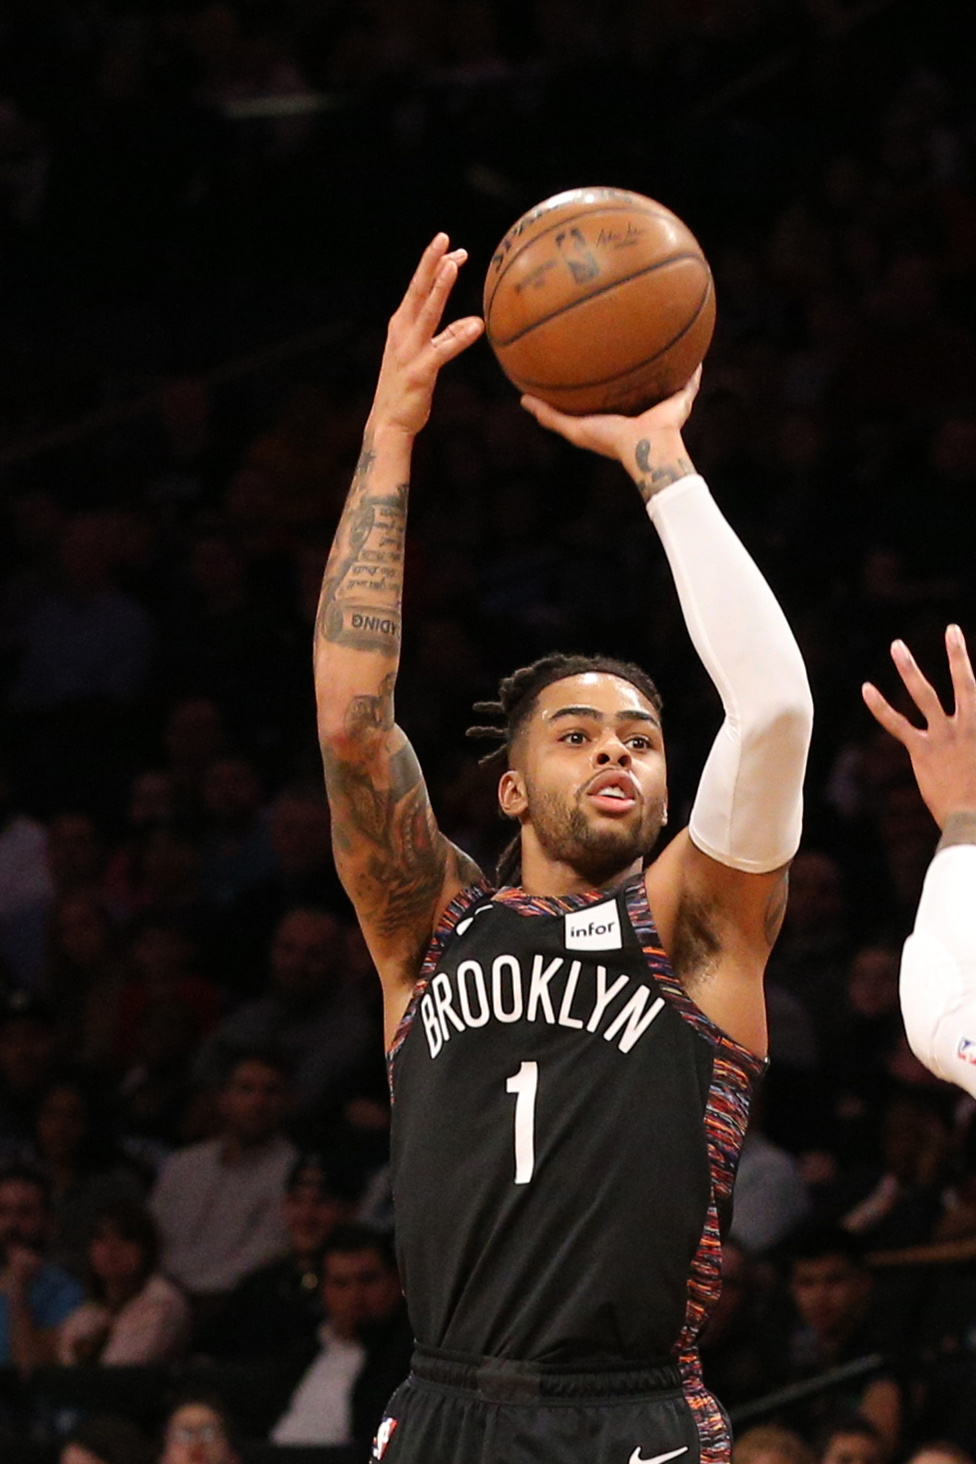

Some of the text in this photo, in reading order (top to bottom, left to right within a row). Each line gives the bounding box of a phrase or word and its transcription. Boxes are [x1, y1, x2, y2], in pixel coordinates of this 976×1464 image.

[570, 922, 615, 938] infor
[420, 954, 665, 1060] BROOKLYN
[506, 1061, 538, 1184] 1
